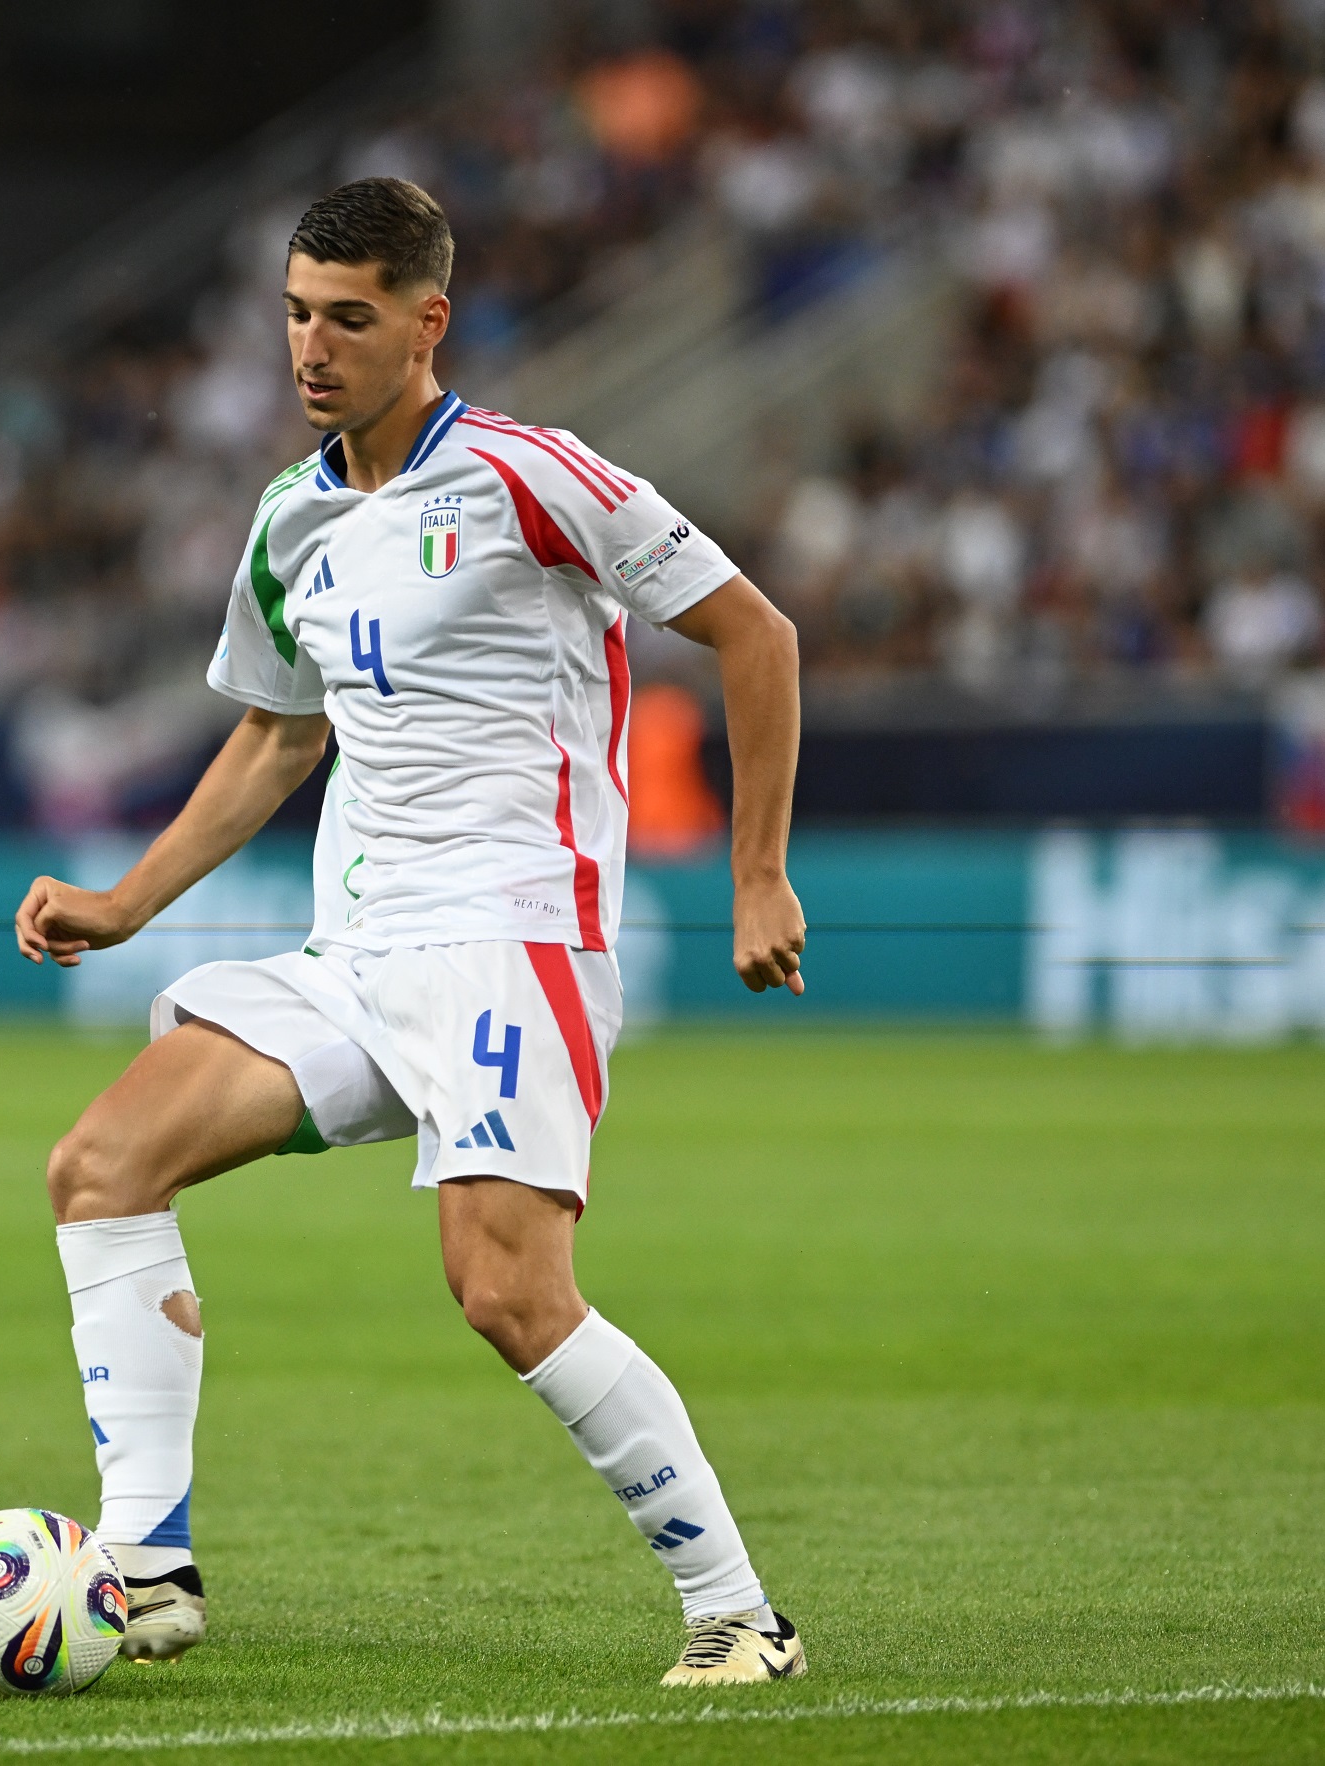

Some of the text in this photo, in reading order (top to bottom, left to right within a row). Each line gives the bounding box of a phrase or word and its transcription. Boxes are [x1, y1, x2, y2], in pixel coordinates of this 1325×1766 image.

[423, 512, 457, 529] ITALIA
[669, 525, 690, 544] 10
[615, 559, 630, 571] UEFA
[619, 540, 673, 580] FOUNDATION
[349, 608, 396, 697] 4
[472, 1008, 522, 1099] 4
[81, 1366, 109, 1384] LIA
[613, 1465, 677, 1502] TALIA
